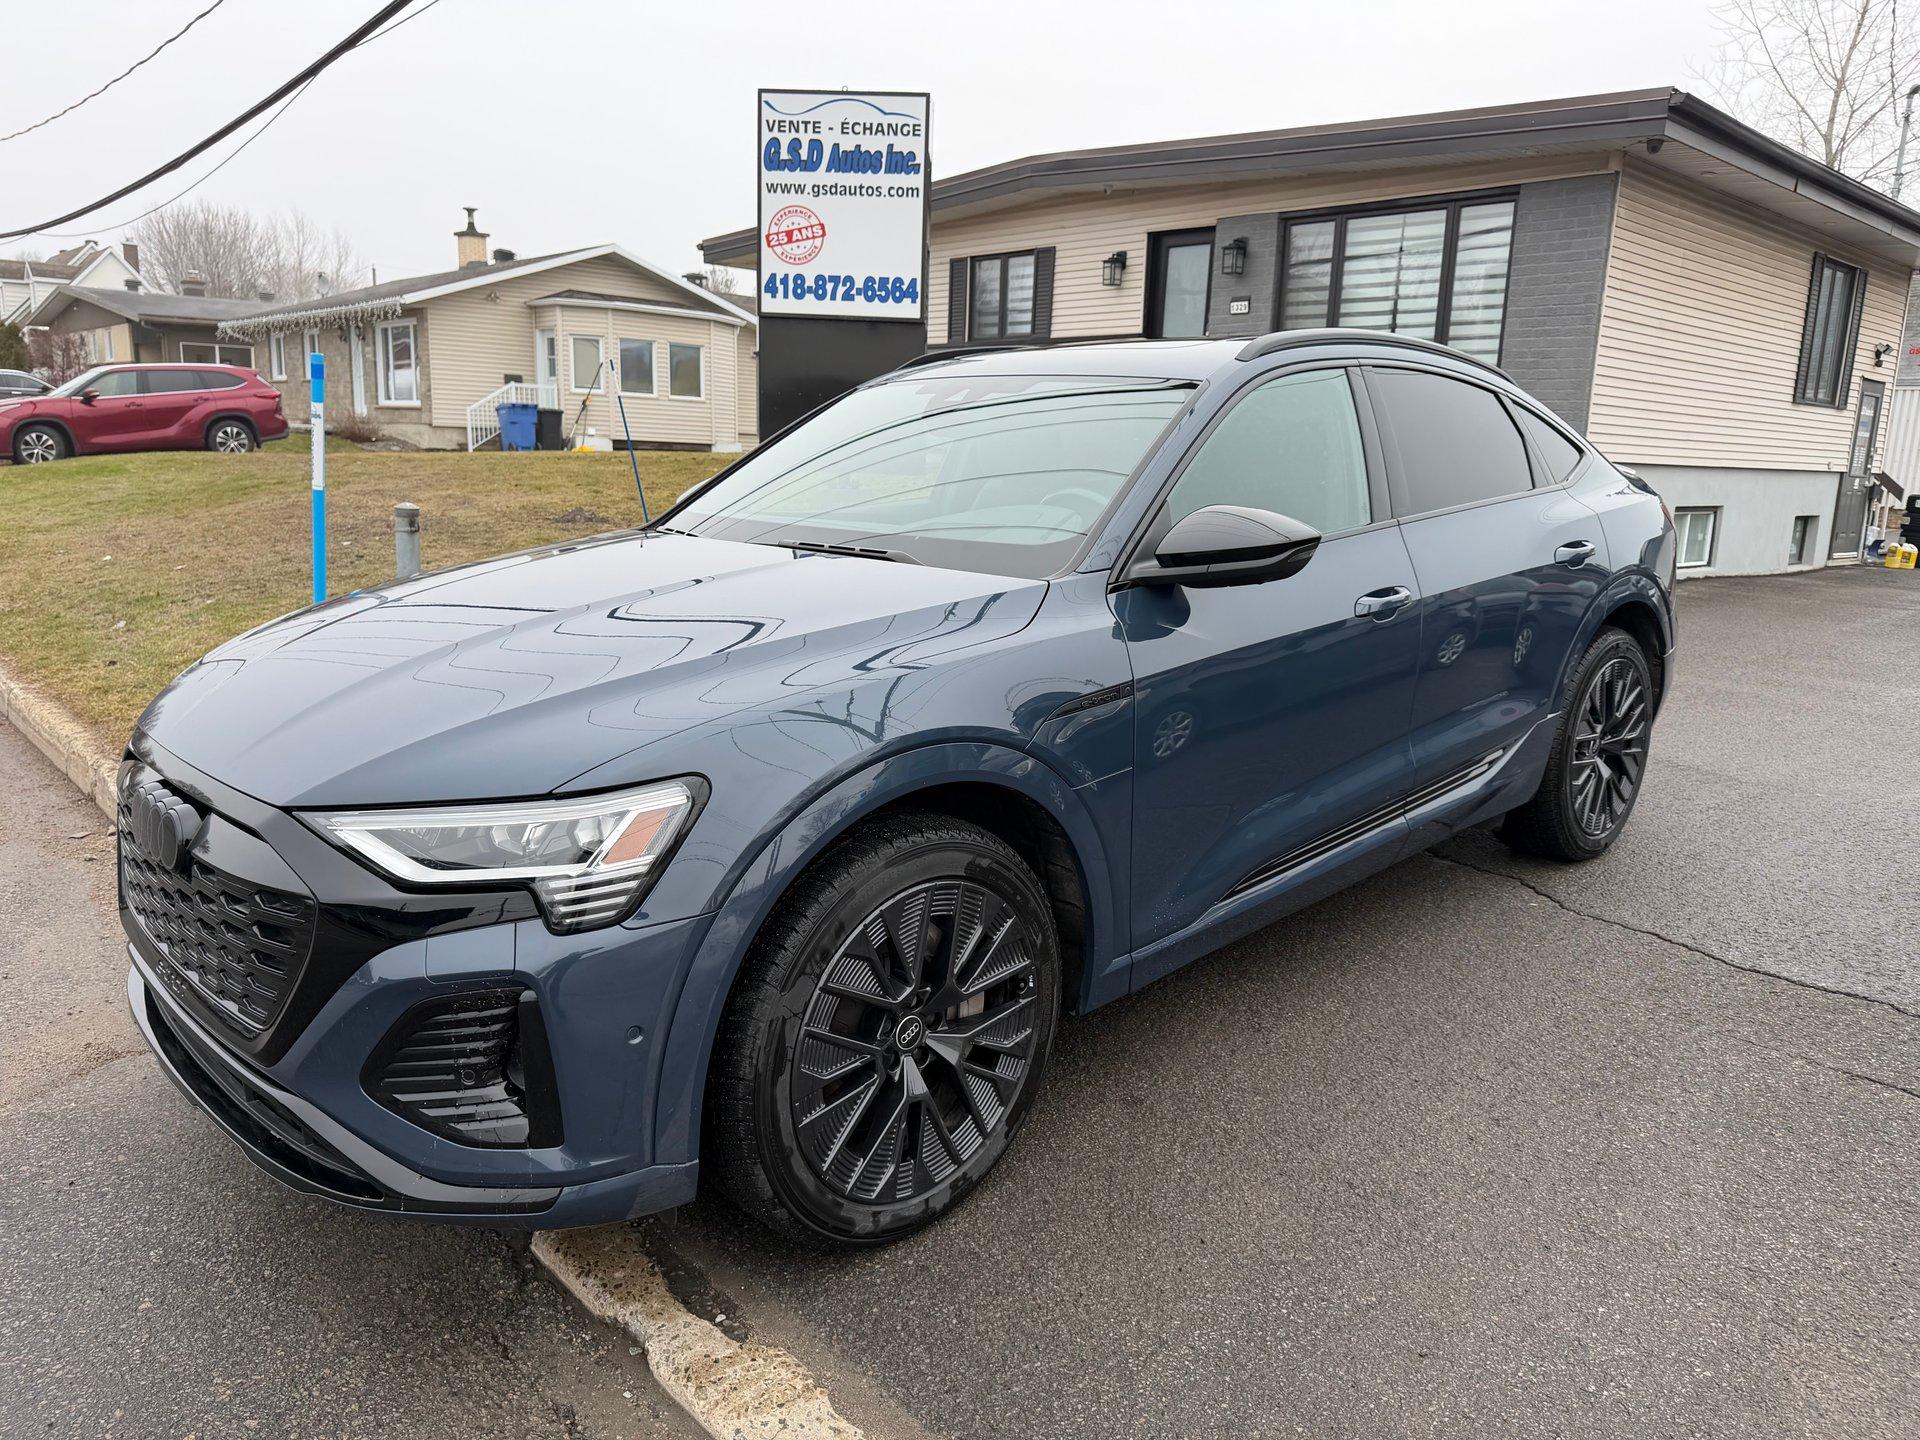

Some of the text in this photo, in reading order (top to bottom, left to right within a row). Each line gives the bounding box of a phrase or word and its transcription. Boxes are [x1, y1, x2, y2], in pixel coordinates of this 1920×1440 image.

[766, 119, 822, 134] VENTE
[840, 117, 922, 137] ÉCHANGE
[763, 136, 824, 173] G.S.D
[825, 142, 884, 175] Autos
[765, 182, 920, 198] www.gsdautos.com
[769, 225, 824, 246] 25 ANS
[763, 272, 919, 304] 418-872-6564
